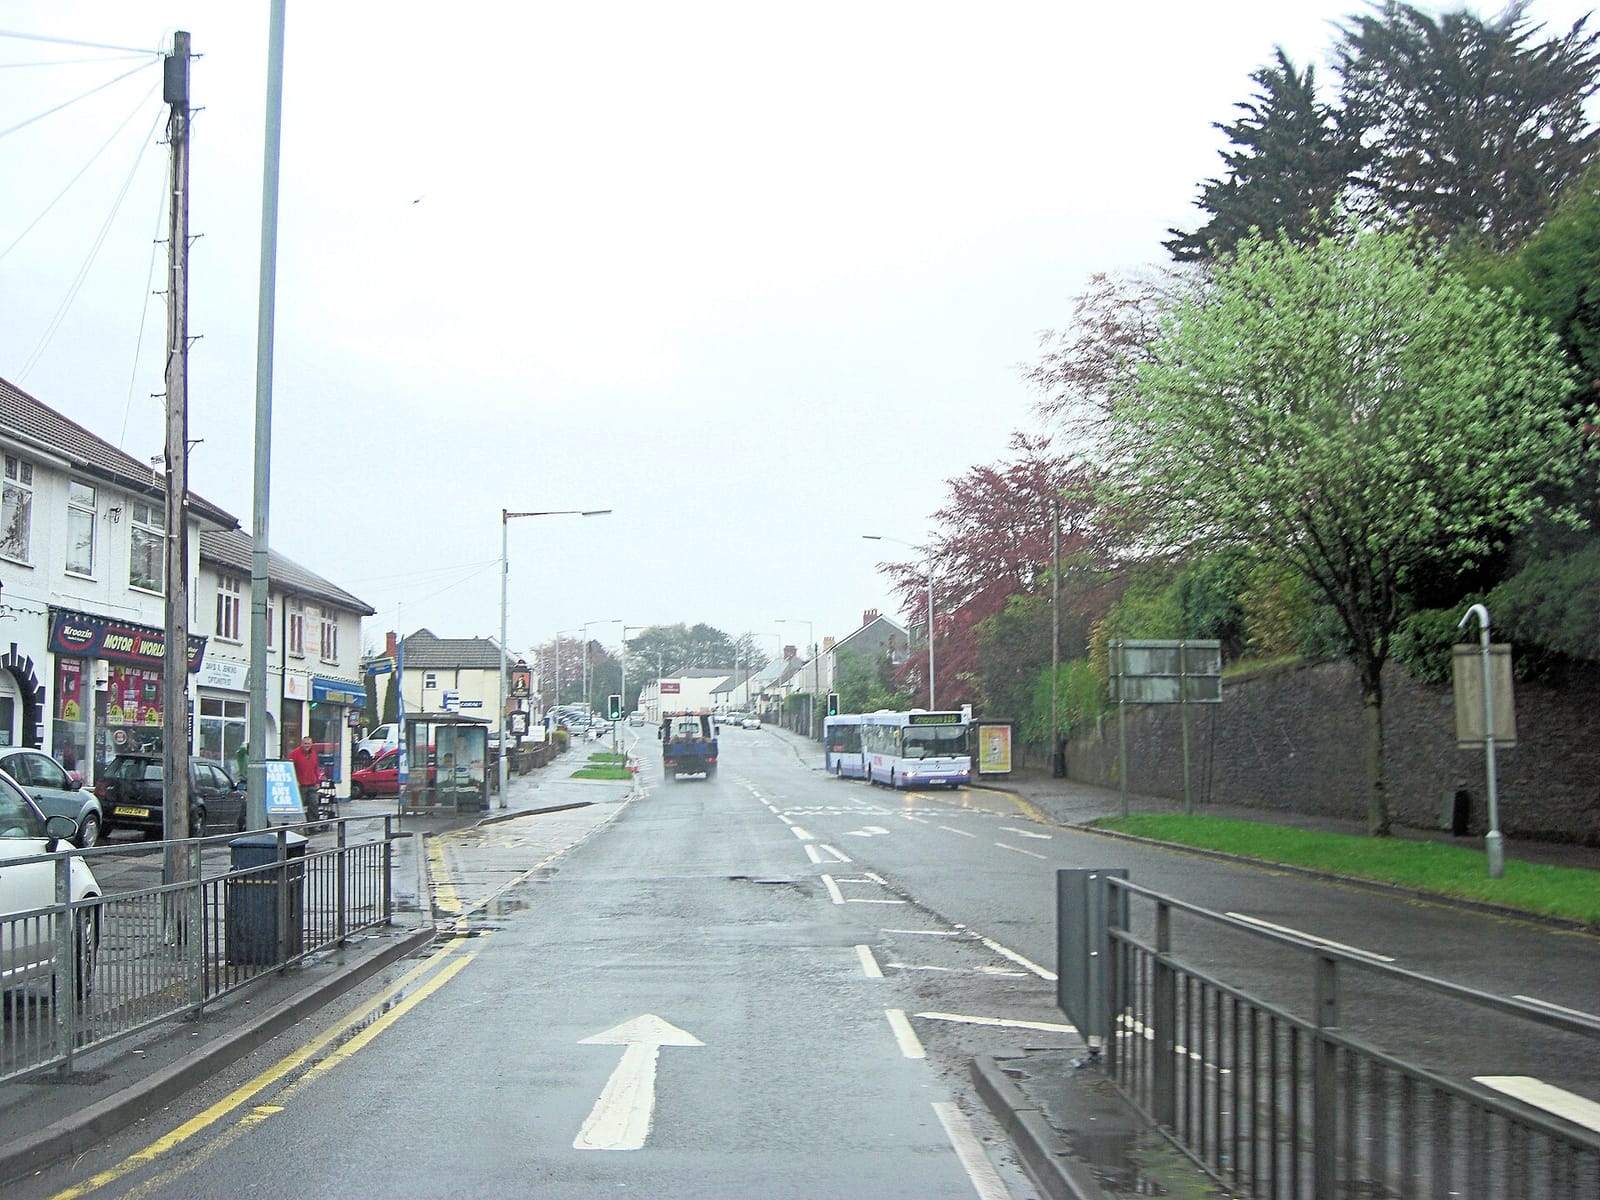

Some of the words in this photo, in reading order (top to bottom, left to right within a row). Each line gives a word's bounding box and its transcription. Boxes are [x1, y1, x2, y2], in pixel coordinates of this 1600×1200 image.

[103, 634, 132, 652] MOTOR
[139, 641, 165, 657] WORLD
[267, 763, 285, 772] CAR
[266, 772, 292, 782] PARTS
[272, 786, 290, 797] ANY
[273, 796, 292, 805] CAR
